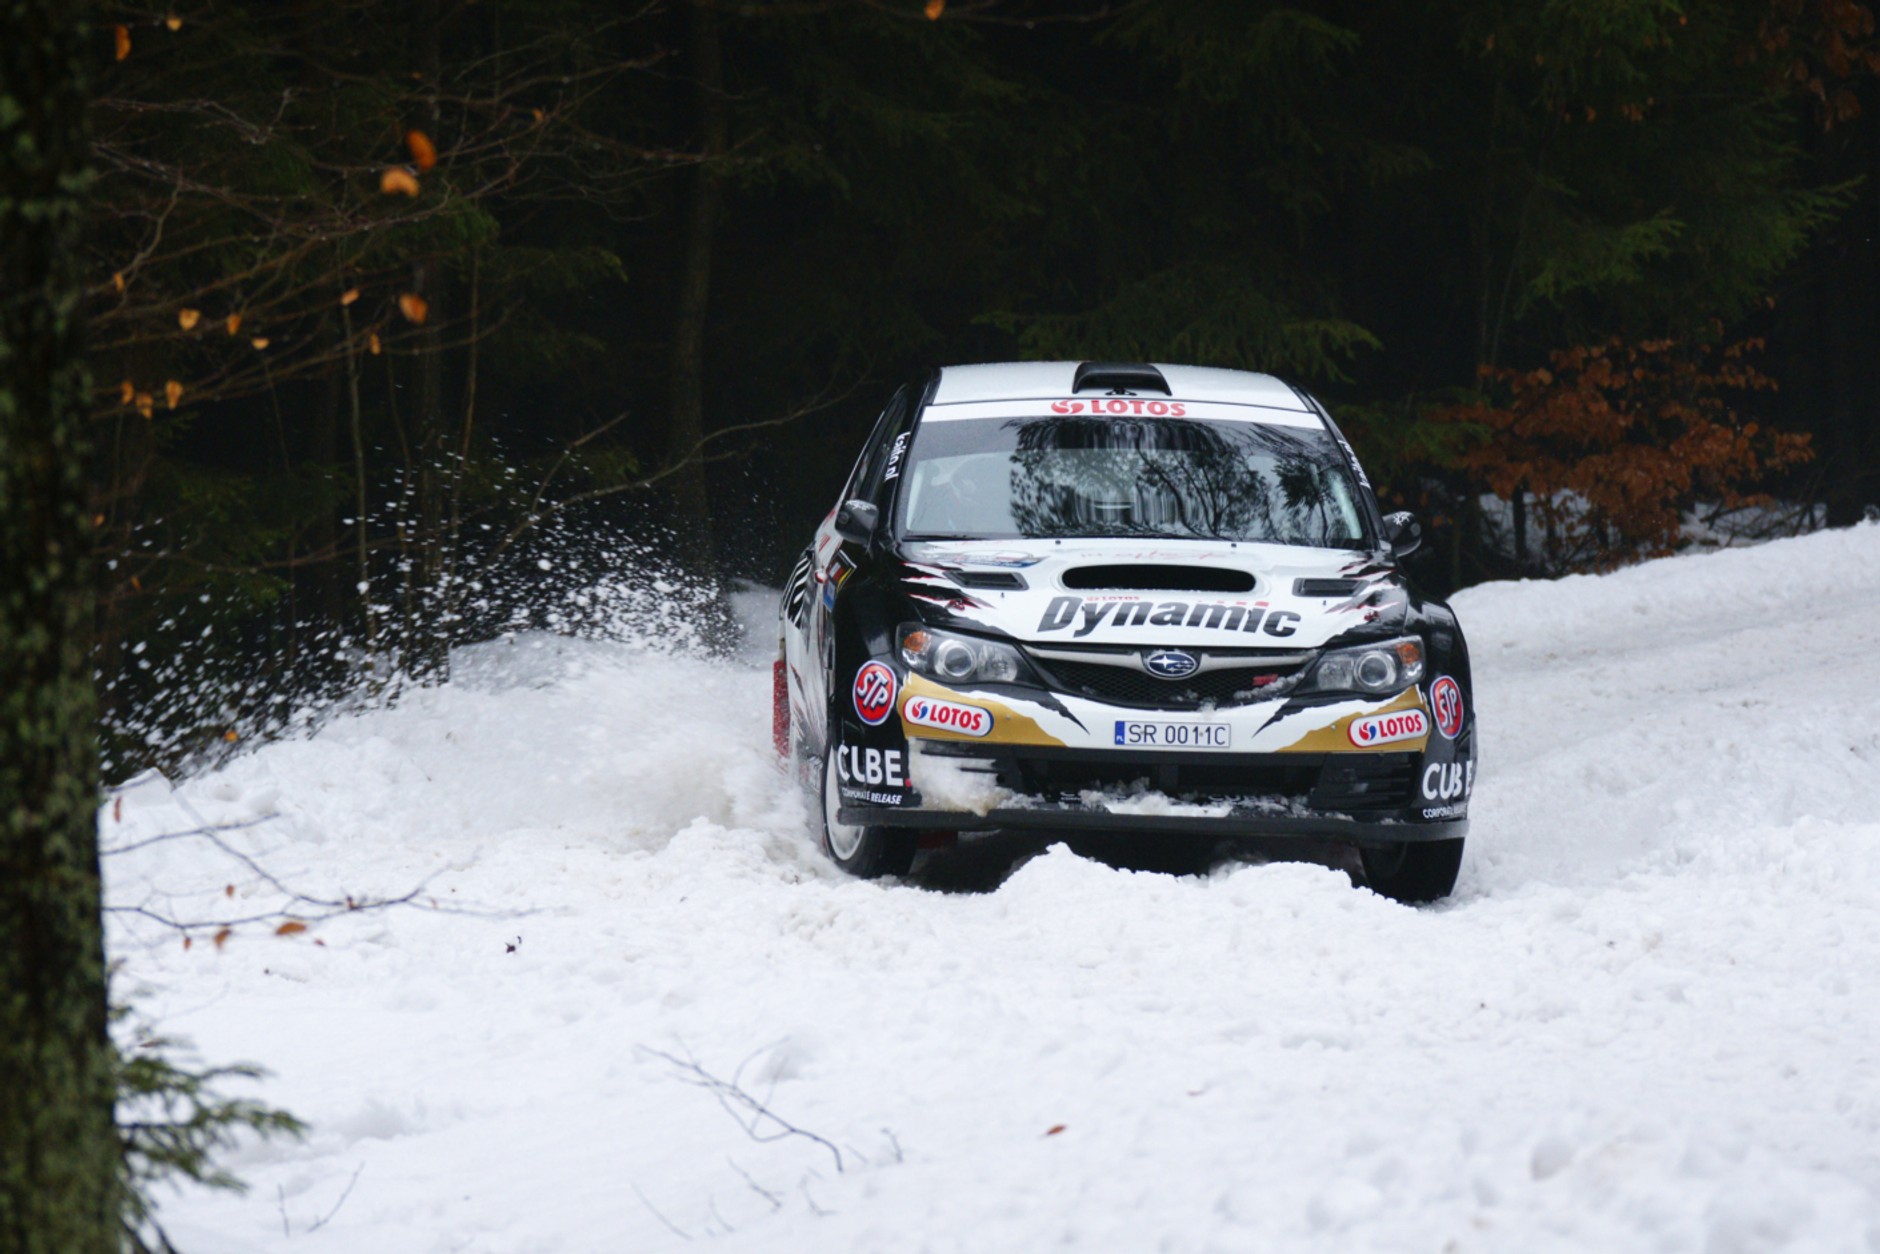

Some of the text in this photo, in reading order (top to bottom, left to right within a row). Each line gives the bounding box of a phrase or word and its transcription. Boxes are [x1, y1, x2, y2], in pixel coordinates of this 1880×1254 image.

[1091, 399, 1186, 417] LOTOS
[1037, 596, 1301, 638] Dynamic
[857, 671, 890, 710] STP
[929, 704, 982, 731] LOTOS
[1439, 683, 1458, 729] STP
[1129, 724, 1226, 745] SR 0011C
[1378, 714, 1422, 738] LOTOS
[870, 792, 902, 805] RELEASE
